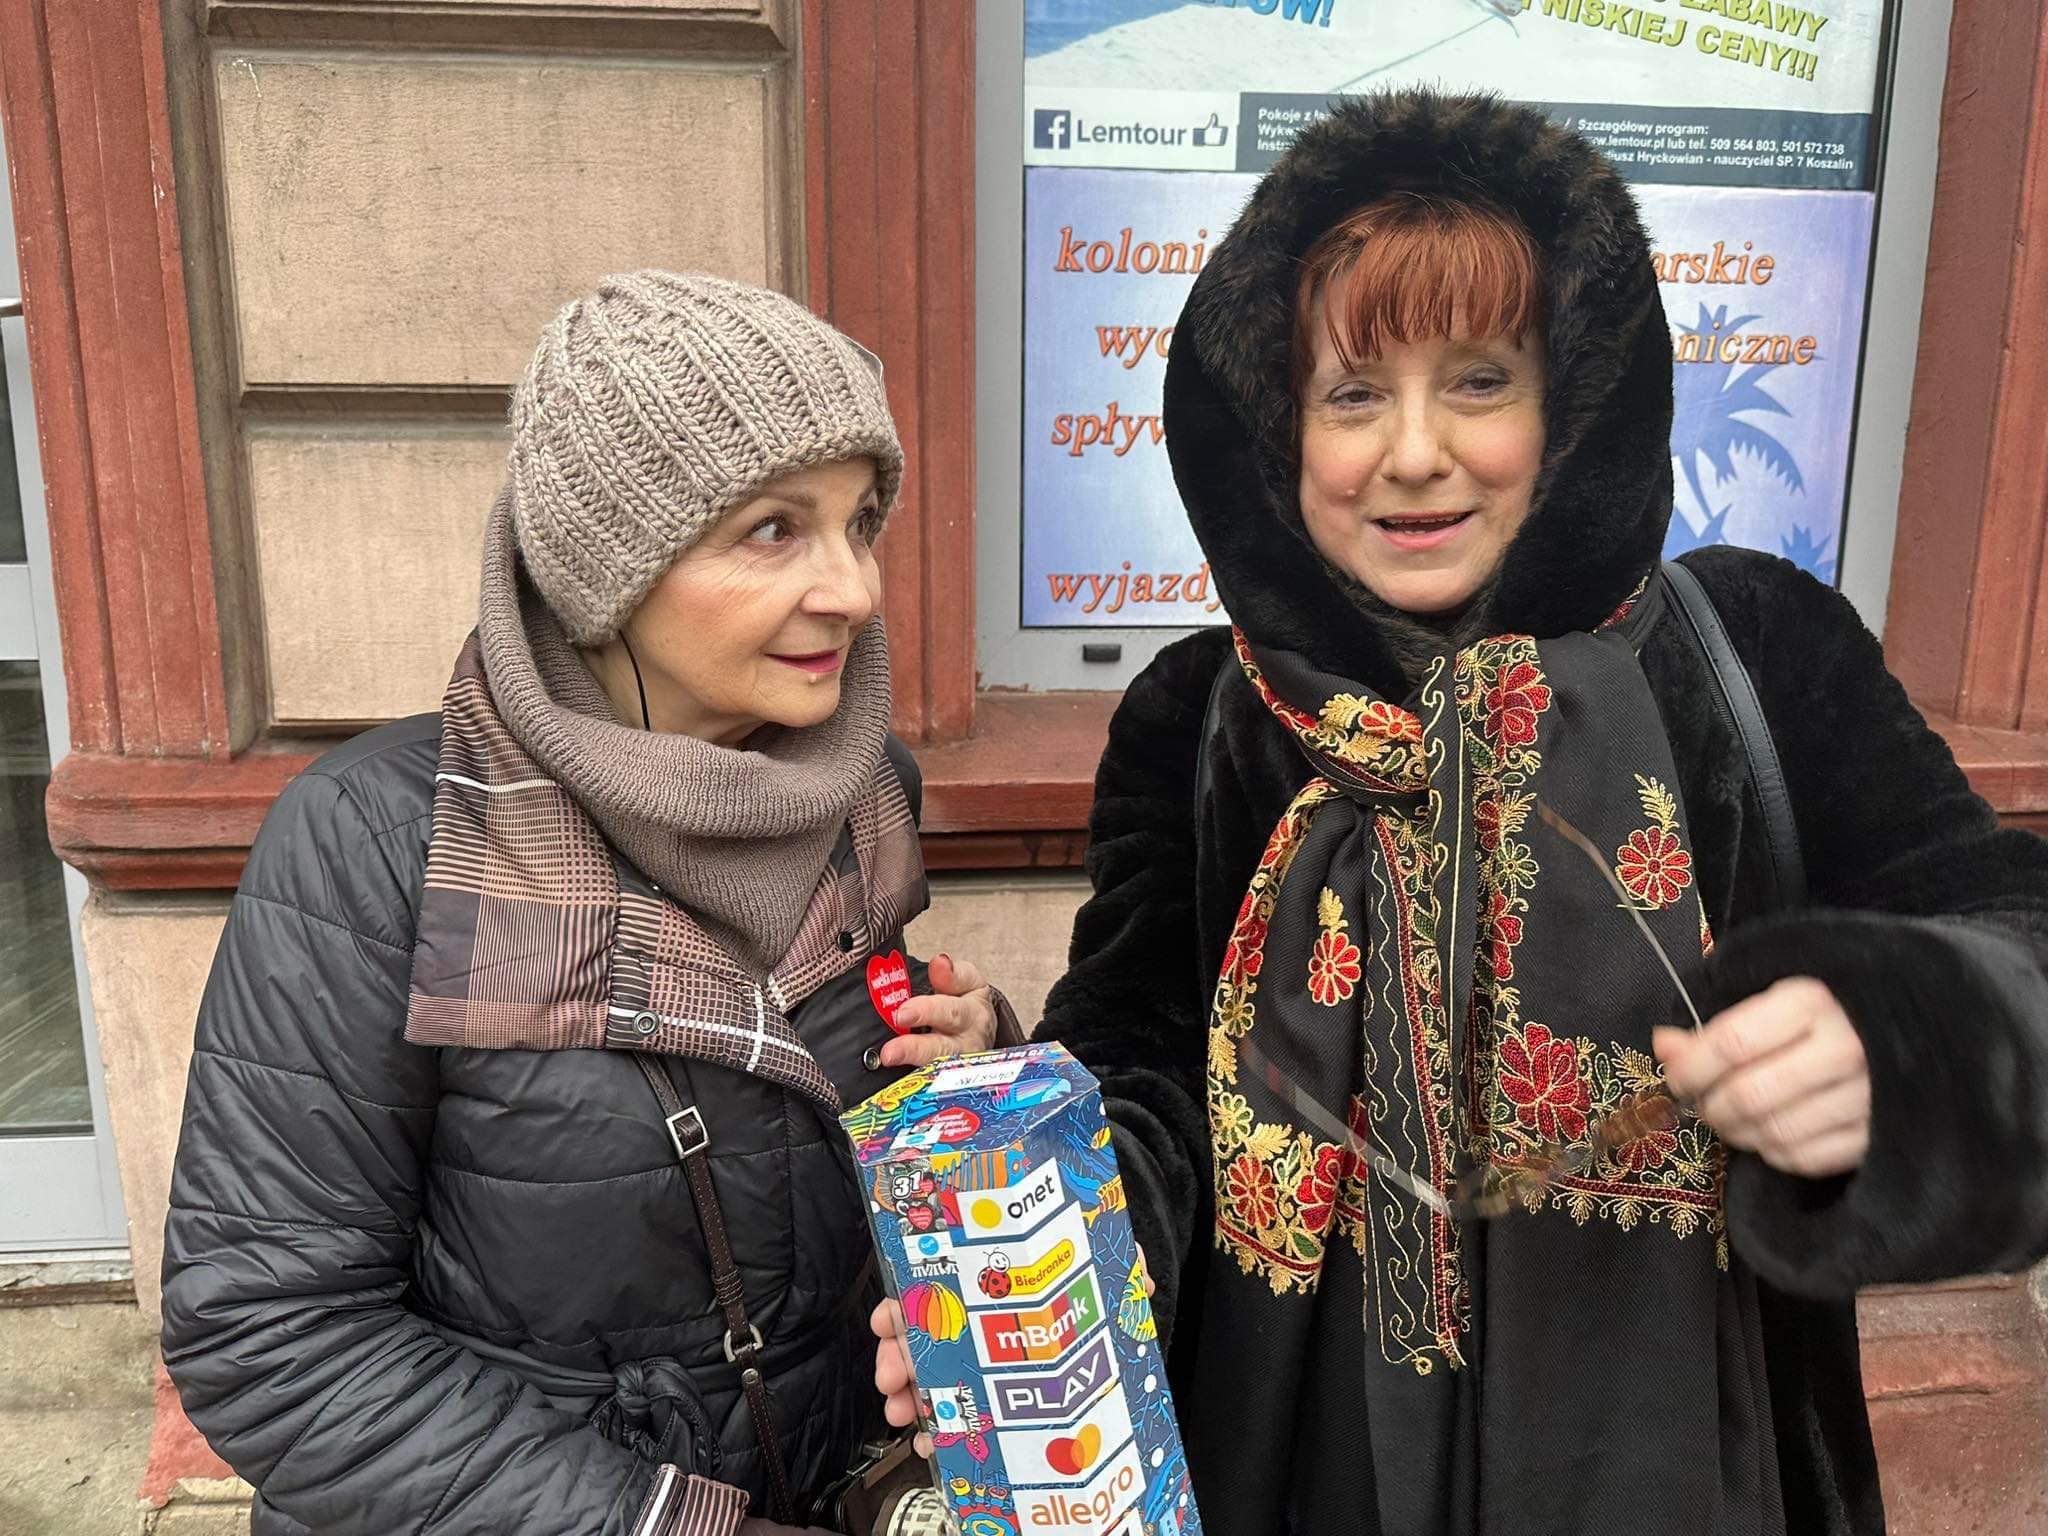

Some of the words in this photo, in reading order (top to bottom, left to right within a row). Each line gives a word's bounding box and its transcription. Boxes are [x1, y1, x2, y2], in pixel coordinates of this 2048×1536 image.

[1543, 0, 1687, 47] NISKIEJ
[1696, 25, 1818, 81] CENY!!!
[1077, 119, 1187, 146] Lemtour
[1258, 107, 1301, 124] Pokoje
[1578, 119, 1653, 135] Szczegółowy
[1655, 124, 1709, 137] program:
[1667, 137, 1685, 149] lub
[1688, 138, 1707, 150] tel.
[1710, 138, 1731, 150] 509
[1733, 138, 1754, 151] 564
[1755, 139, 1779, 153] 803,
[1781, 141, 1802, 153] 501
[1804, 141, 1822, 154] 572
[1824, 143, 1845, 155] 738
[1713, 154, 1774, 168] nauczyciel
[1776, 157, 1794, 167] SP.
[1796, 157, 1804, 167] 7
[1806, 156, 1853, 169] Koszalin
[1054, 225, 1208, 274] koloni
[1650, 240, 1775, 285] arskie
[1671, 321, 1817, 365] niczne
[892, 1169, 924, 1200] 31
[1007, 1174, 1055, 1219] onet
[1014, 1249, 1071, 1287] Biedronka
[996, 1296, 1089, 1349] mBank
[1005, 1351, 1100, 1411] PLAY
[1031, 1465, 1133, 1526] allegro
